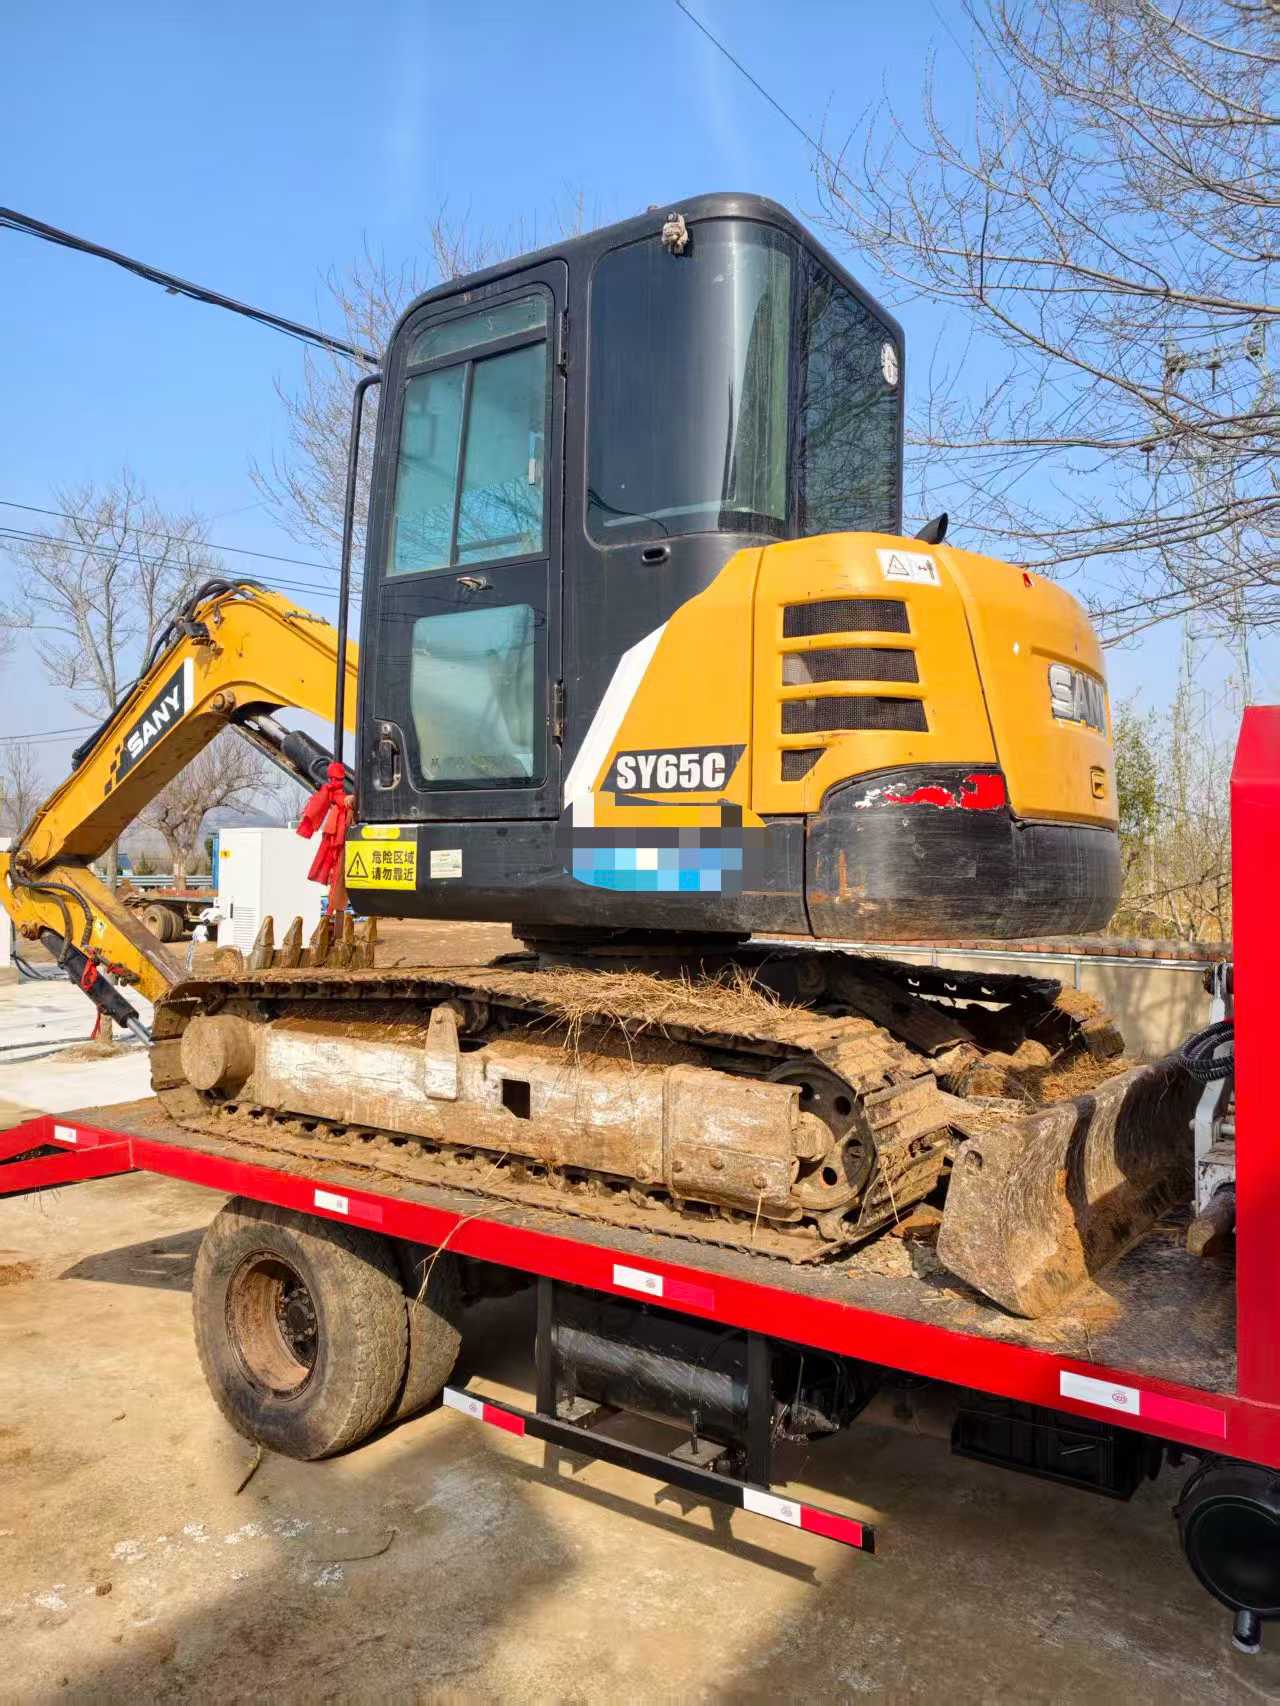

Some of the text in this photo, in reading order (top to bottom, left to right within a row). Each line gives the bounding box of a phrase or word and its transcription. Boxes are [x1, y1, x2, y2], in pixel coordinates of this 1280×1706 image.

[1048, 663, 1105, 731] SAN
[126, 685, 180, 759] SANY
[616, 752, 726, 790] SY65C
[371, 850, 415, 865] 危险区域
[371, 867, 414, 881] 请勿靠近
